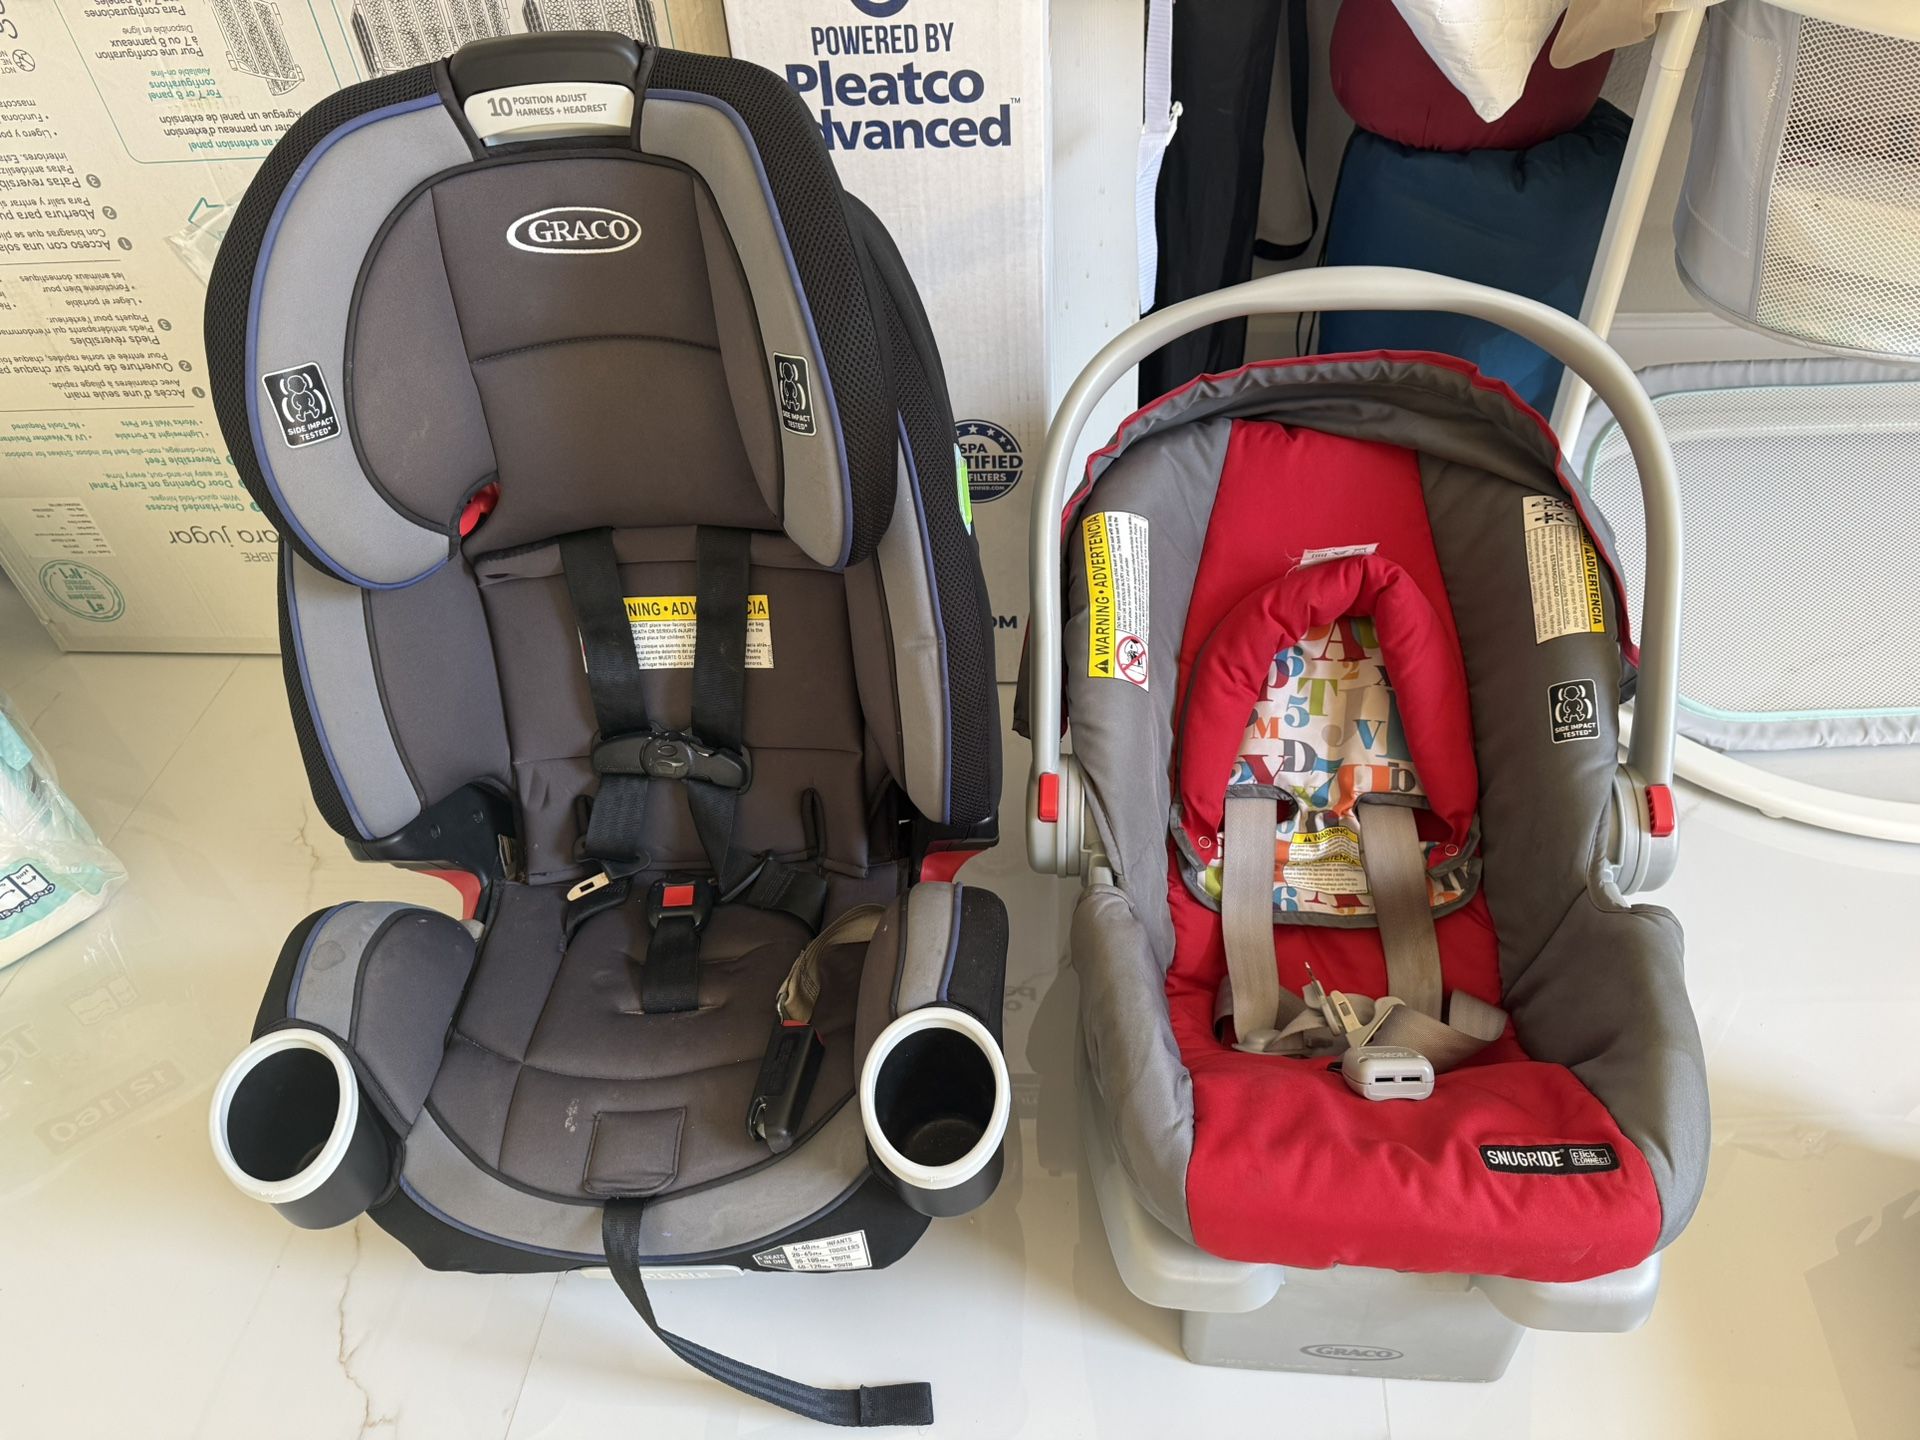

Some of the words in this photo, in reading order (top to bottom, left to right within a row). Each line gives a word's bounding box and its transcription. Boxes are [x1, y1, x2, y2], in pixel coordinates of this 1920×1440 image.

[84, 6, 160, 18] configuraciones
[162, 6, 185, 16] Para
[123, 26, 140, 35] ligne
[154, 24, 193, 34] Disponible
[110, 36, 156, 47] panneaux
[158, 38, 166, 47] 8
[184, 37, 190, 46] 7
[192, 36, 197, 44] à
[811, 24, 918, 55] POWERED
[925, 22, 954, 52] BY
[95, 49, 158, 60] configuration
[160, 49, 177, 57] une
[181, 47, 203, 57] Pour
[149, 78, 215, 88] configurations
[785, 60, 984, 106] Pleatco
[148, 90, 173, 101] panel
[207, 89, 222, 98] For
[487, 97, 513, 116] 10
[513, 95, 553, 105] POSITION
[555, 94, 587, 103] ADJUST
[516, 107, 555, 116] HARNESS
[563, 104, 608, 114] HEADREST
[2, 113, 43, 122] Funciona
[206, 114, 218, 123] de
[220, 111, 245, 123] panel
[262, 109, 301, 119] Agregue
[159, 115, 203, 125] extensión
[15, 129, 20, 138] y
[22, 128, 51, 138] Ligero
[163, 127, 216, 137] d'extension
[218, 123, 256, 134] panneau
[189, 140, 213, 152] panel
[216, 139, 259, 149] extension
[261, 138, 273, 146] an
[47, 165, 74, 175] Patas
[0, 179, 44, 191] reversib
[47, 177, 81, 189] Patas
[10, 199, 37, 208] entrar
[39, 197, 43, 206] y
[48, 198, 66, 207] salir
[68, 197, 90, 206] Para
[16, 209, 41, 220] para
[45, 209, 95, 220] Abertura
[27, 230, 44, 239] que
[47, 228, 84, 239] bisagras
[87, 228, 106, 237] Con
[528, 220, 630, 242] GRACO
[23, 242, 43, 251] una
[49, 241, 68, 250] con
[71, 239, 110, 250] Acceso
[70, 336, 126, 346] réversibles
[129, 335, 160, 345] Pieds
[14, 364, 51, 375] chaque
[55, 365, 70, 373] sur
[74, 362, 101, 373] porte
[104, 364, 117, 373] de
[120, 362, 173, 373] Ouverture
[64, 391, 90, 400] main
[93, 390, 120, 400] seule
[124, 390, 151, 399] d'une
[154, 389, 185, 399] Accès
[288, 426, 306, 435] SIDE
[307, 417, 334, 430] IMPACT
[961, 444, 987, 453] SPA
[145, 456, 166, 466] Feet
[169, 455, 221, 465] Reversible
[967, 456, 1023, 469] TIFIED
[969, 473, 1006, 481] FILTERS
[89, 481, 117, 491] Panel
[120, 479, 146, 490] Every
[148, 481, 161, 489] on
[164, 479, 205, 489] Opening
[209, 479, 233, 489] Door
[146, 503, 179, 512] Access
[182, 502, 244, 511] One-Handed
[169, 525, 234, 547] jugar
[1087, 514, 1108, 588] ADVERTENCIA
[1586, 555, 1602, 624] ADVERTENCIA
[628, 602, 660, 616] NING
[1095, 596, 1110, 655] WARNING
[1297, 677, 1338, 716] T
[1285, 695, 1309, 728] 5
[1251, 717, 1281, 739] M
[1354, 720, 1385, 749] V
[1280, 739, 1316, 772] D
[1313, 829, 1348, 840] WARNING
[1487, 1151, 1563, 1167] SNUGRIDE
[827, 1238, 852, 1246] INFANTS
[829, 1244, 860, 1252] TODDLERS
[1316, 1347, 1392, 1357] GRACO
